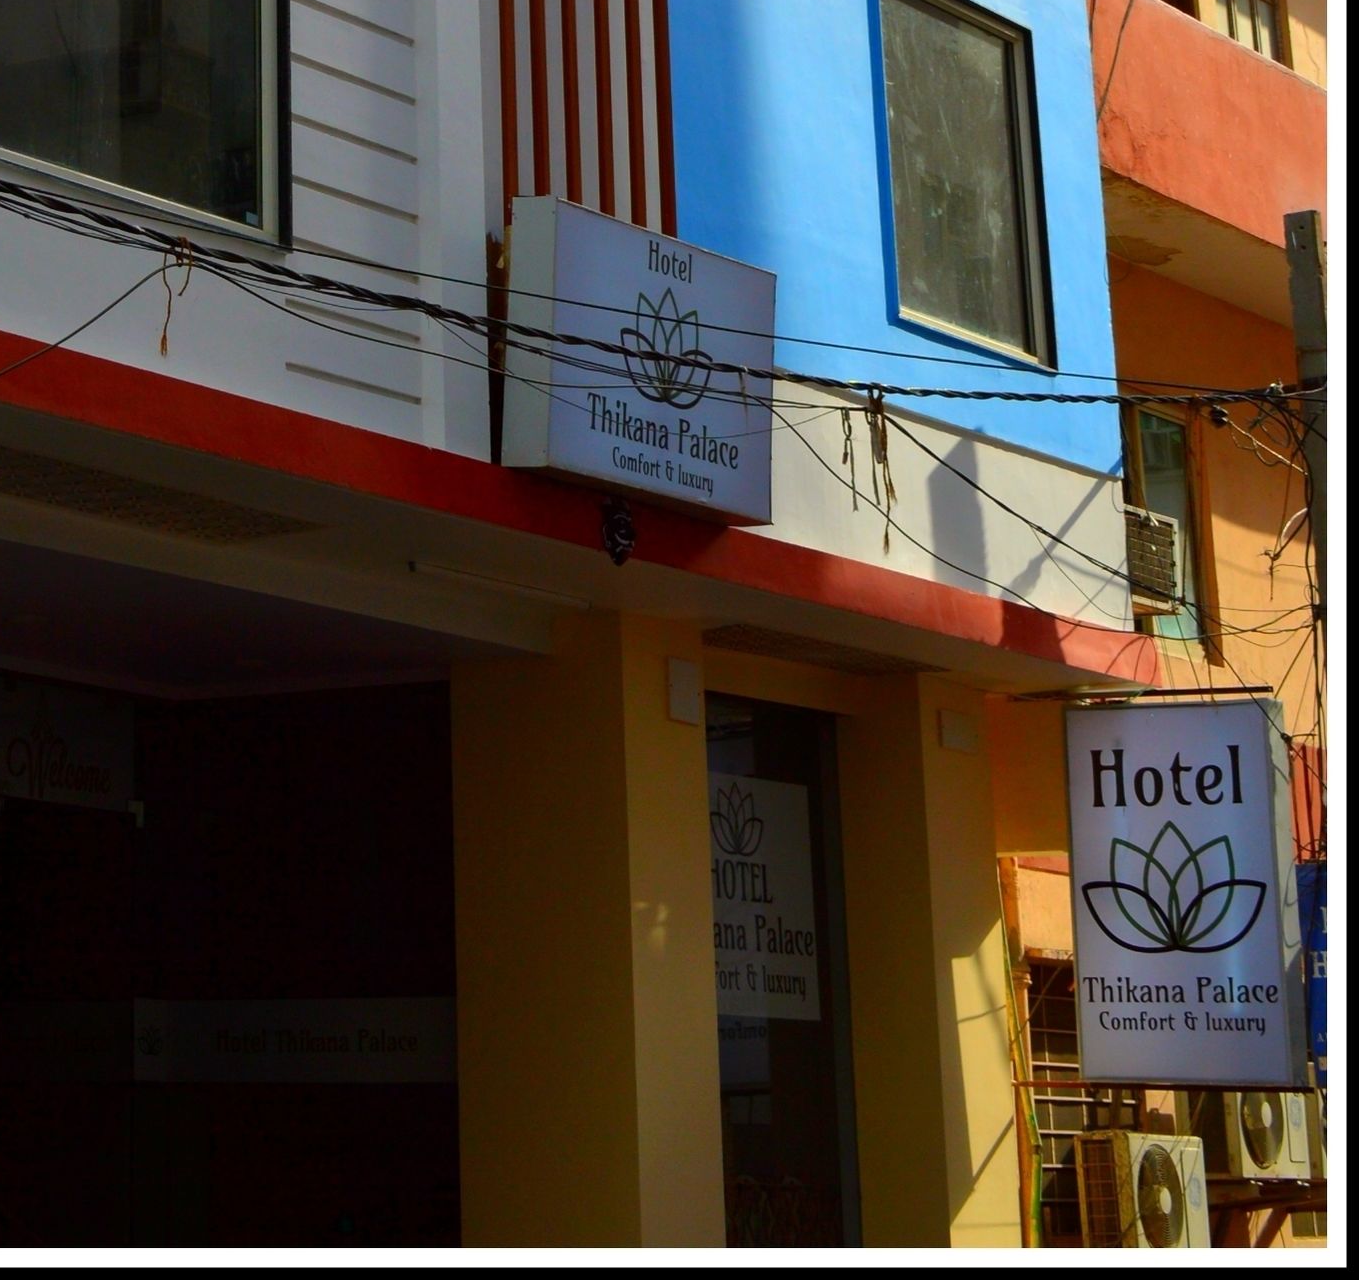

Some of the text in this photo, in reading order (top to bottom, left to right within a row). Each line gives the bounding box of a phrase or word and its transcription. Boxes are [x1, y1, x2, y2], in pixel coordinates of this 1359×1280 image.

[648, 239, 693, 284] Hotel
[587, 391, 739, 470] Thikana Palace
[612, 445, 714, 496] Comfort & luxury
[1090, 744, 1243, 809] Hotel
[755, 914, 815, 957] Palace
[746, 962, 758, 992] &
[762, 964, 807, 1002] luxury
[1082, 976, 1279, 1004] Thikana Palace
[357, 1027, 419, 1053] Palace
[1099, 1010, 1266, 1037] Comfort & luxury
